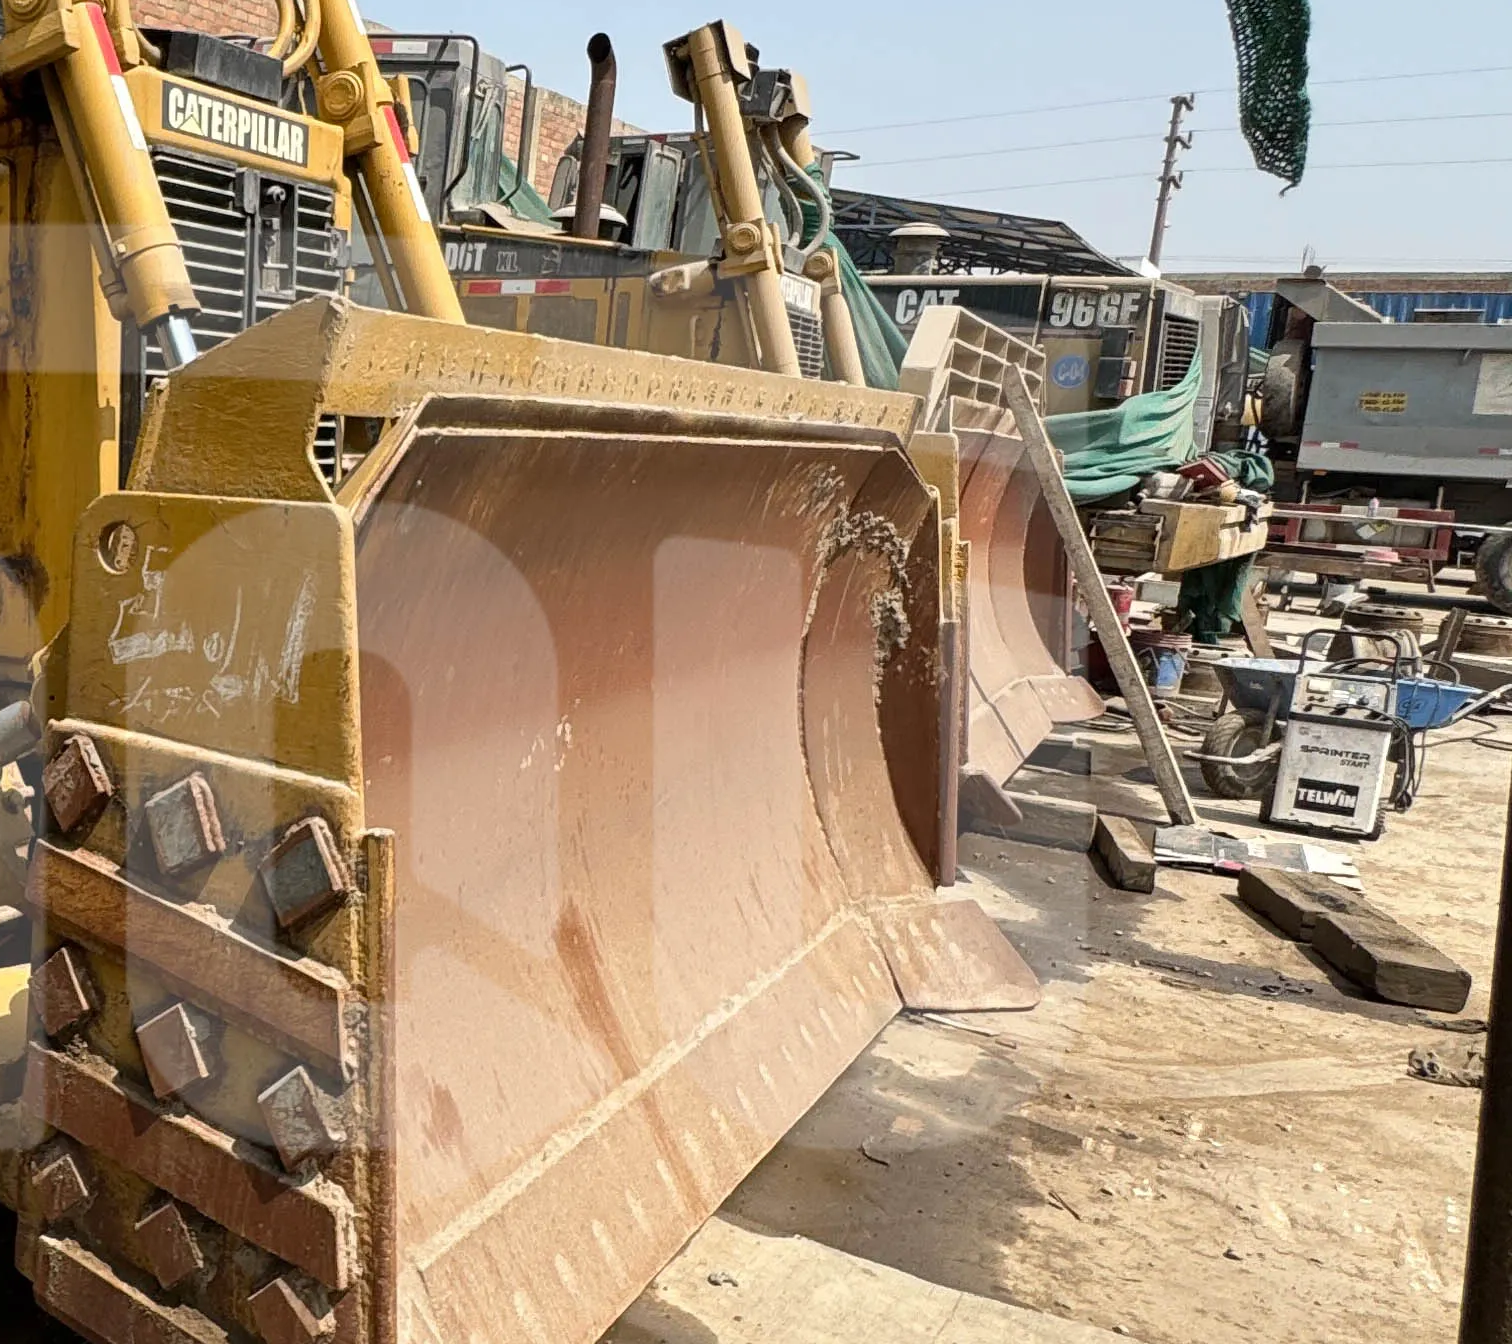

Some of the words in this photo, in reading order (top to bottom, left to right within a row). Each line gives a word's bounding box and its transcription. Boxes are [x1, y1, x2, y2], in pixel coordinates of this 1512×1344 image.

[168, 87, 304, 164] CATERPILLAR
[445, 242, 487, 272] D6T
[495, 250, 519, 273] XL
[1049, 290, 1141, 328] 966F
[1299, 743, 1371, 762] SPRINTER
[1339, 758, 1370, 769] START
